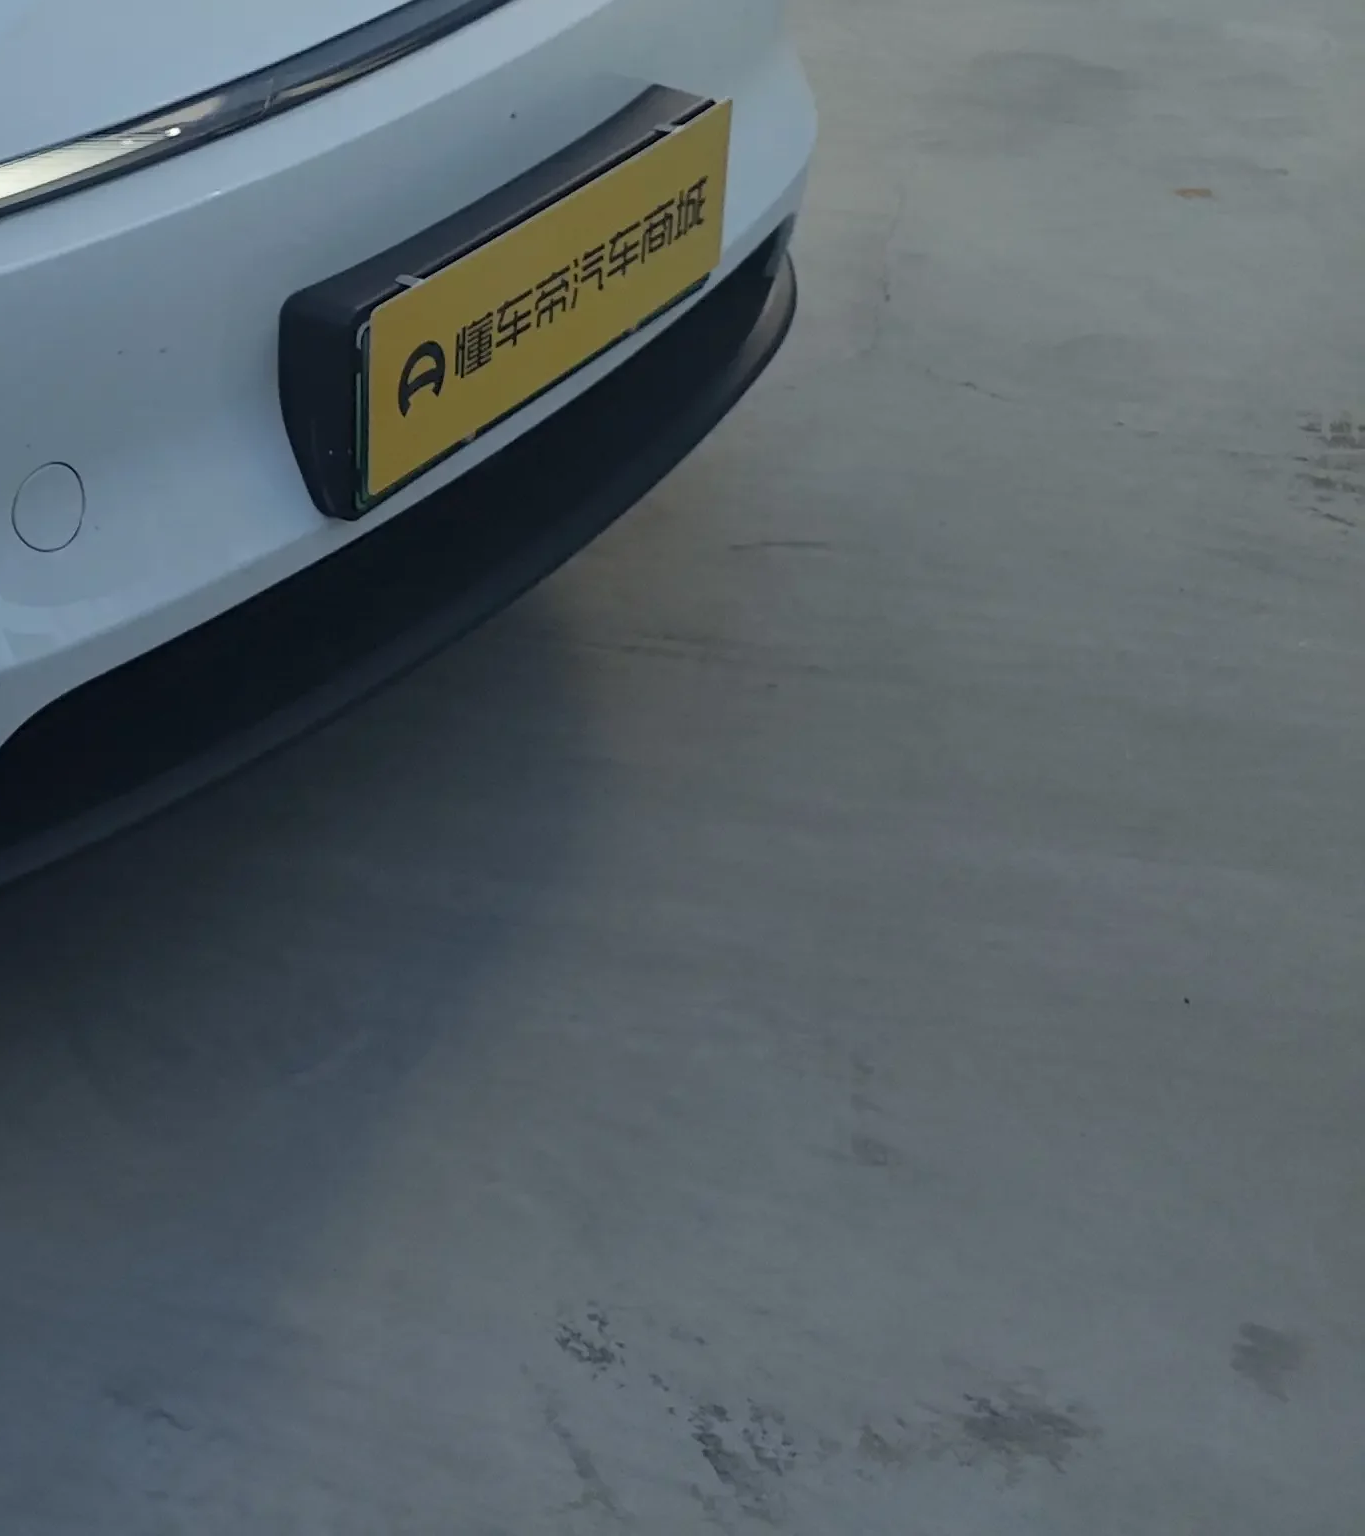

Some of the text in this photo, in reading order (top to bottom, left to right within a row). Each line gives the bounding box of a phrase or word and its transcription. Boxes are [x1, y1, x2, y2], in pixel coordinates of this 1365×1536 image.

[454, 176, 709, 378] 懂车帝汽车商城
